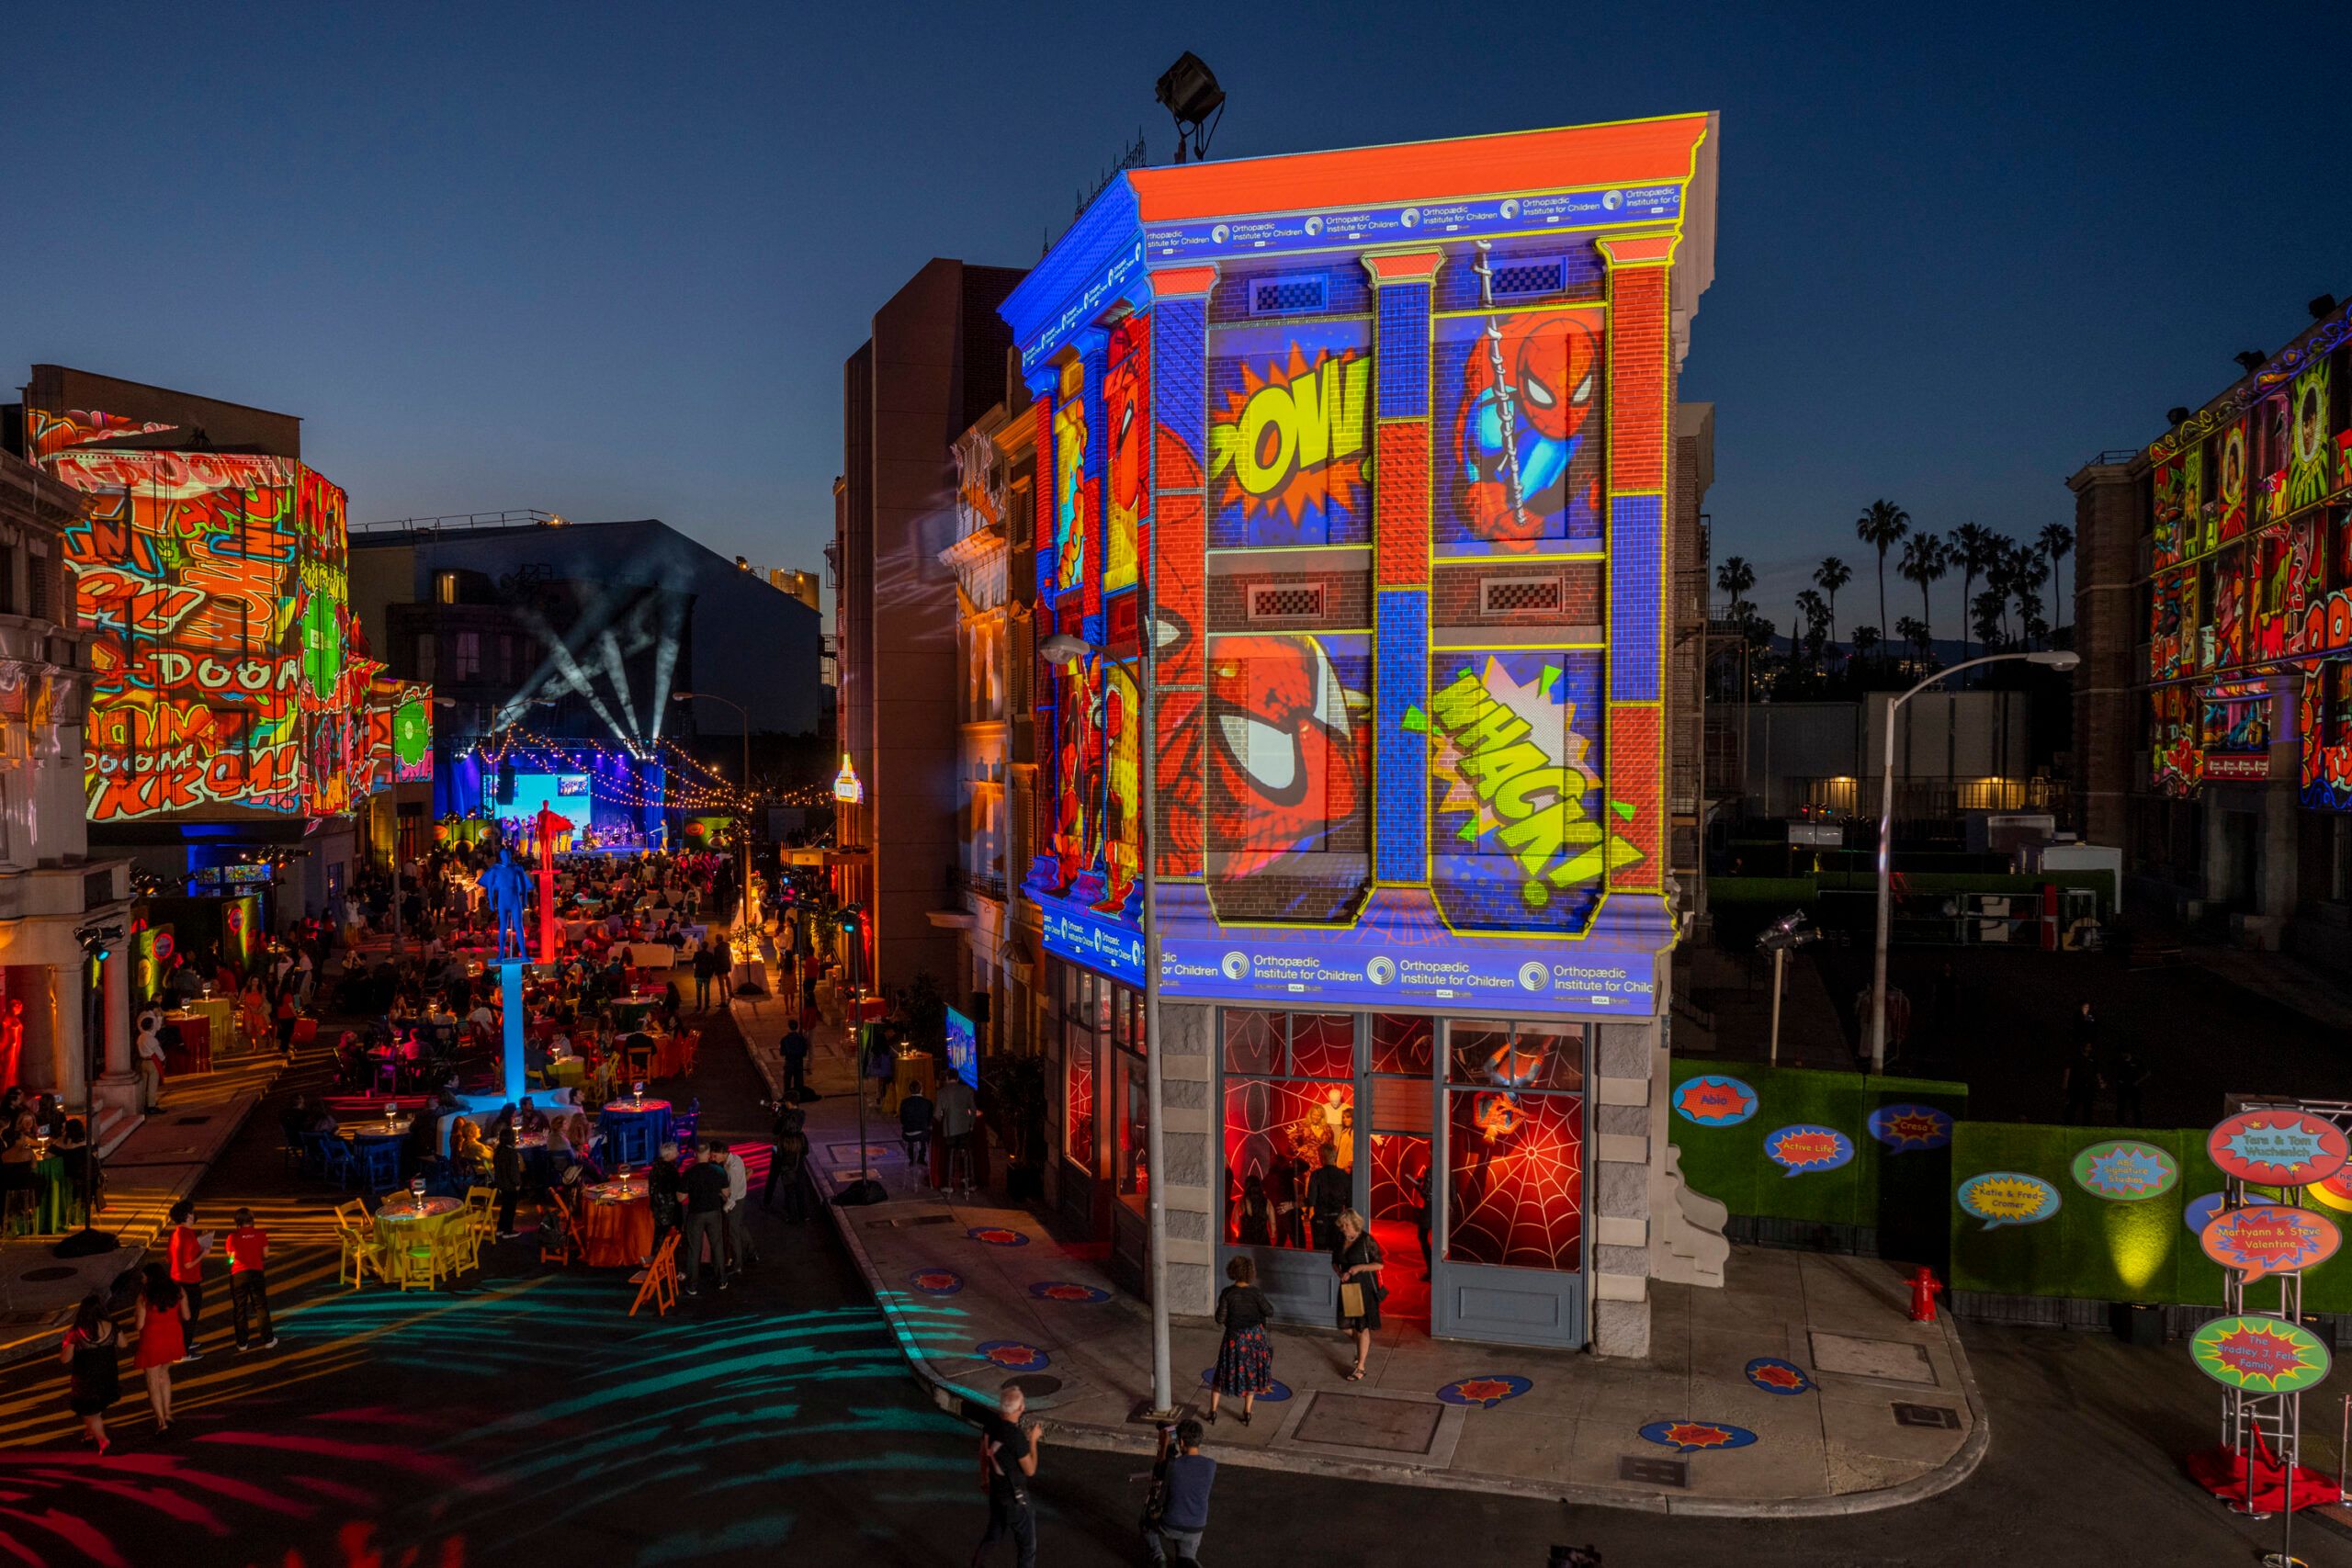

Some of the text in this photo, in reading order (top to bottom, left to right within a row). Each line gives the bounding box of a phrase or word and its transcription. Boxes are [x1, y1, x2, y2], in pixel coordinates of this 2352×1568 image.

[1625, 187, 1675, 198] Orthopædic
[1522, 196, 1569, 208] Orthopædic
[1626, 197, 1659, 208] Institute
[1659, 195, 1671, 205] for
[1422, 205, 1468, 217] Orthopædic
[1523, 202, 1600, 216] Institute for Children
[1326, 213, 1370, 225] Orthopædic
[1423, 210, 1498, 224] Institute for Children
[1232, 222, 1275, 233] Orthopædic
[1326, 220, 1399, 232] Institute for Children
[1147, 230, 1183, 240] rthopædic
[1233, 228, 1303, 241] Institute for Children
[1148, 236, 1210, 247] stitute for Children
[1253, 954, 1320, 968] Orthopædic
[1399, 960, 1470, 974] Orthopædic
[1161, 964, 1218, 976] or Children
[1254, 967, 1363, 982] Institute for Children
[1554, 964, 1626, 978] Orthopædic
[1401, 974, 1515, 987] Institute for Children
[1555, 978, 1602, 991] Institute
[1605, 980, 1622, 992] for
[2243, 1134, 2312, 1145] Tara & Tom
[1783, 1143, 1834, 1153] Active Life
[2104, 1166, 2148, 1177] Signature
[2109, 1175, 2143, 1184] Studios
[2018, 1190, 2039, 1200] Fred
[2277, 1227, 2285, 1235] &
[2290, 1227, 2323, 1235] Steve
[2245, 1240, 2297, 1249] Valentine
[2249, 1336, 2268, 1346] The
[2218, 1344, 2257, 1358] Bradley
[2240, 1359, 2275, 1371] Family
